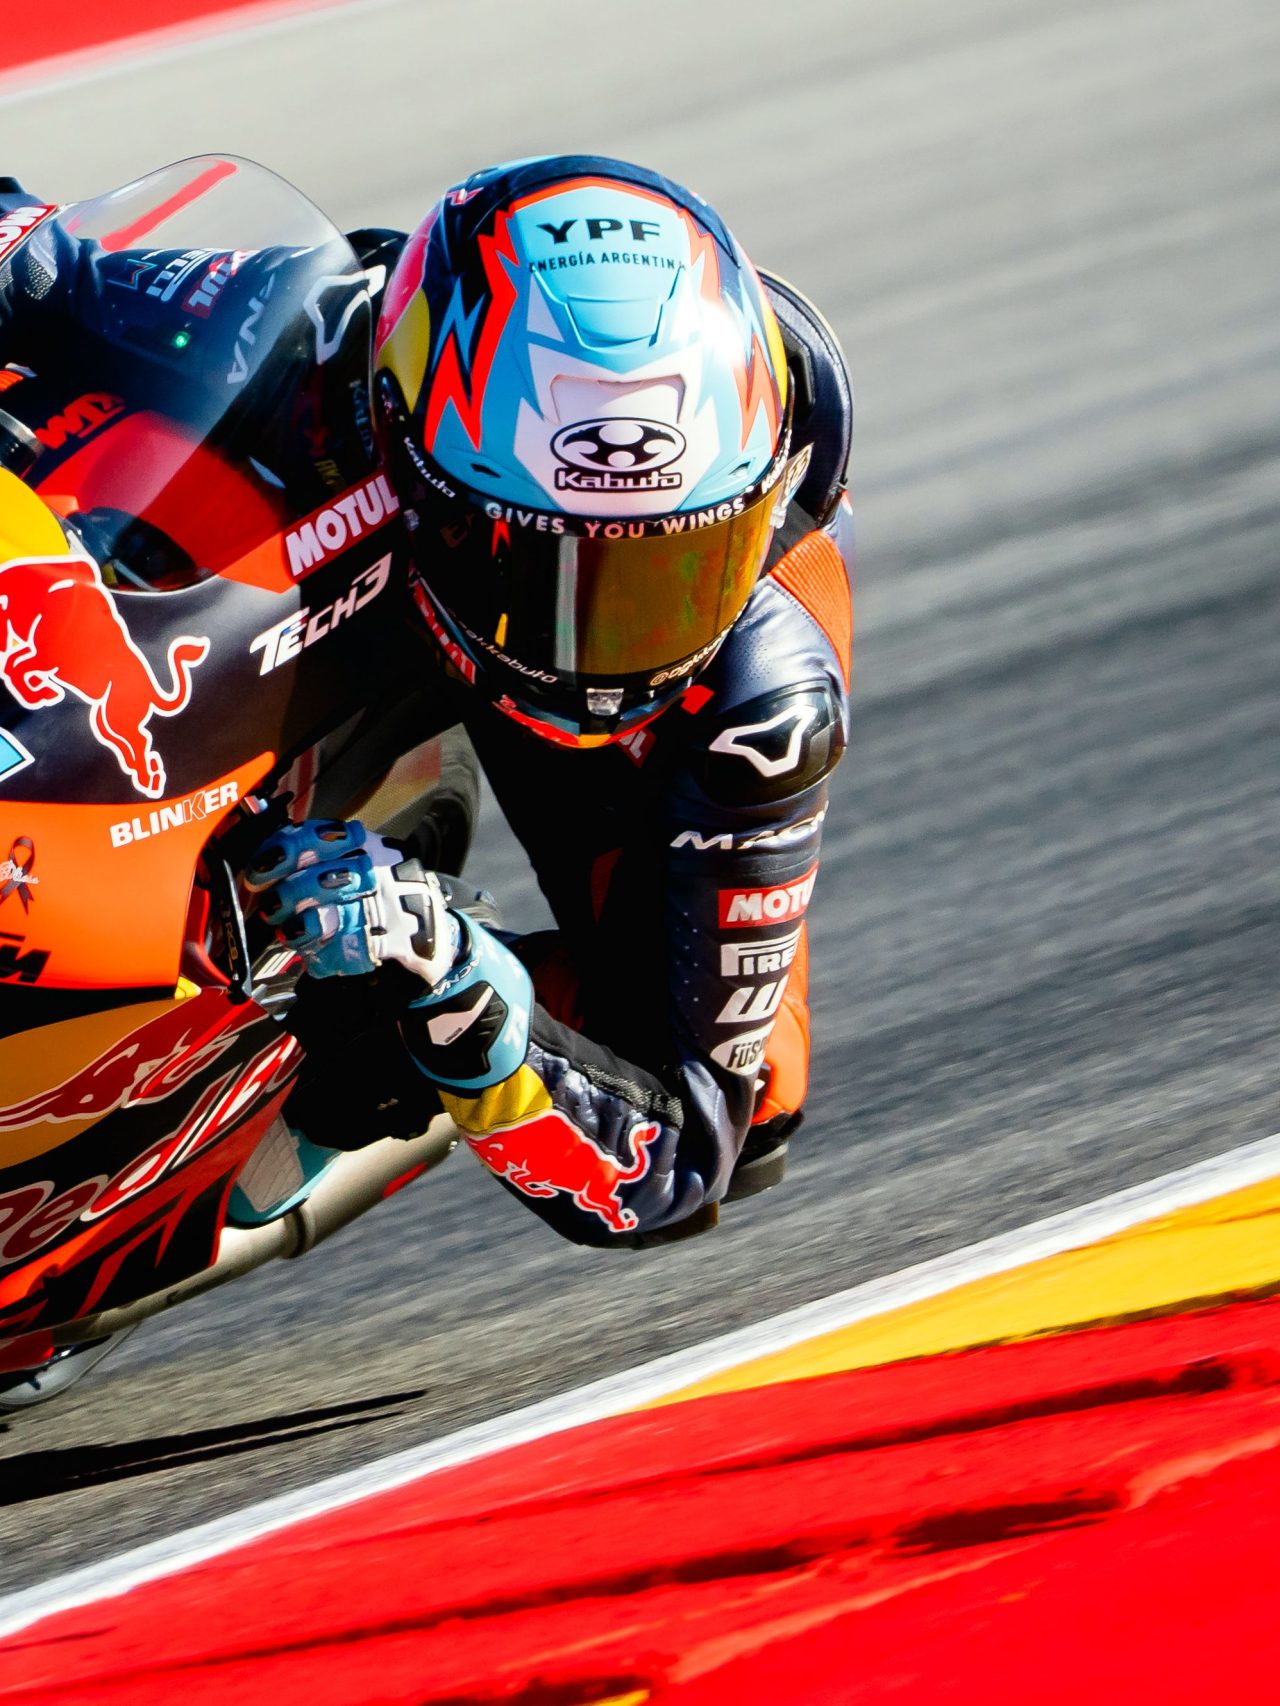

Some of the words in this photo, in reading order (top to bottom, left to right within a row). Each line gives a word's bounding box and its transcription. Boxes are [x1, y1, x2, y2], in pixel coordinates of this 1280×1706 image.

[536, 218, 660, 245] YPF
[556, 469, 682, 490] Kabuto
[285, 474, 400, 577] MOTUL
[485, 501, 565, 535] GIVES
[585, 522, 645, 539] YOU
[662, 497, 745, 535] WINGS
[250, 552, 392, 676] TECH3
[109, 781, 239, 848] BLINKER
[726, 868, 818, 922] MOTU
[720, 925, 802, 977] PIRE
